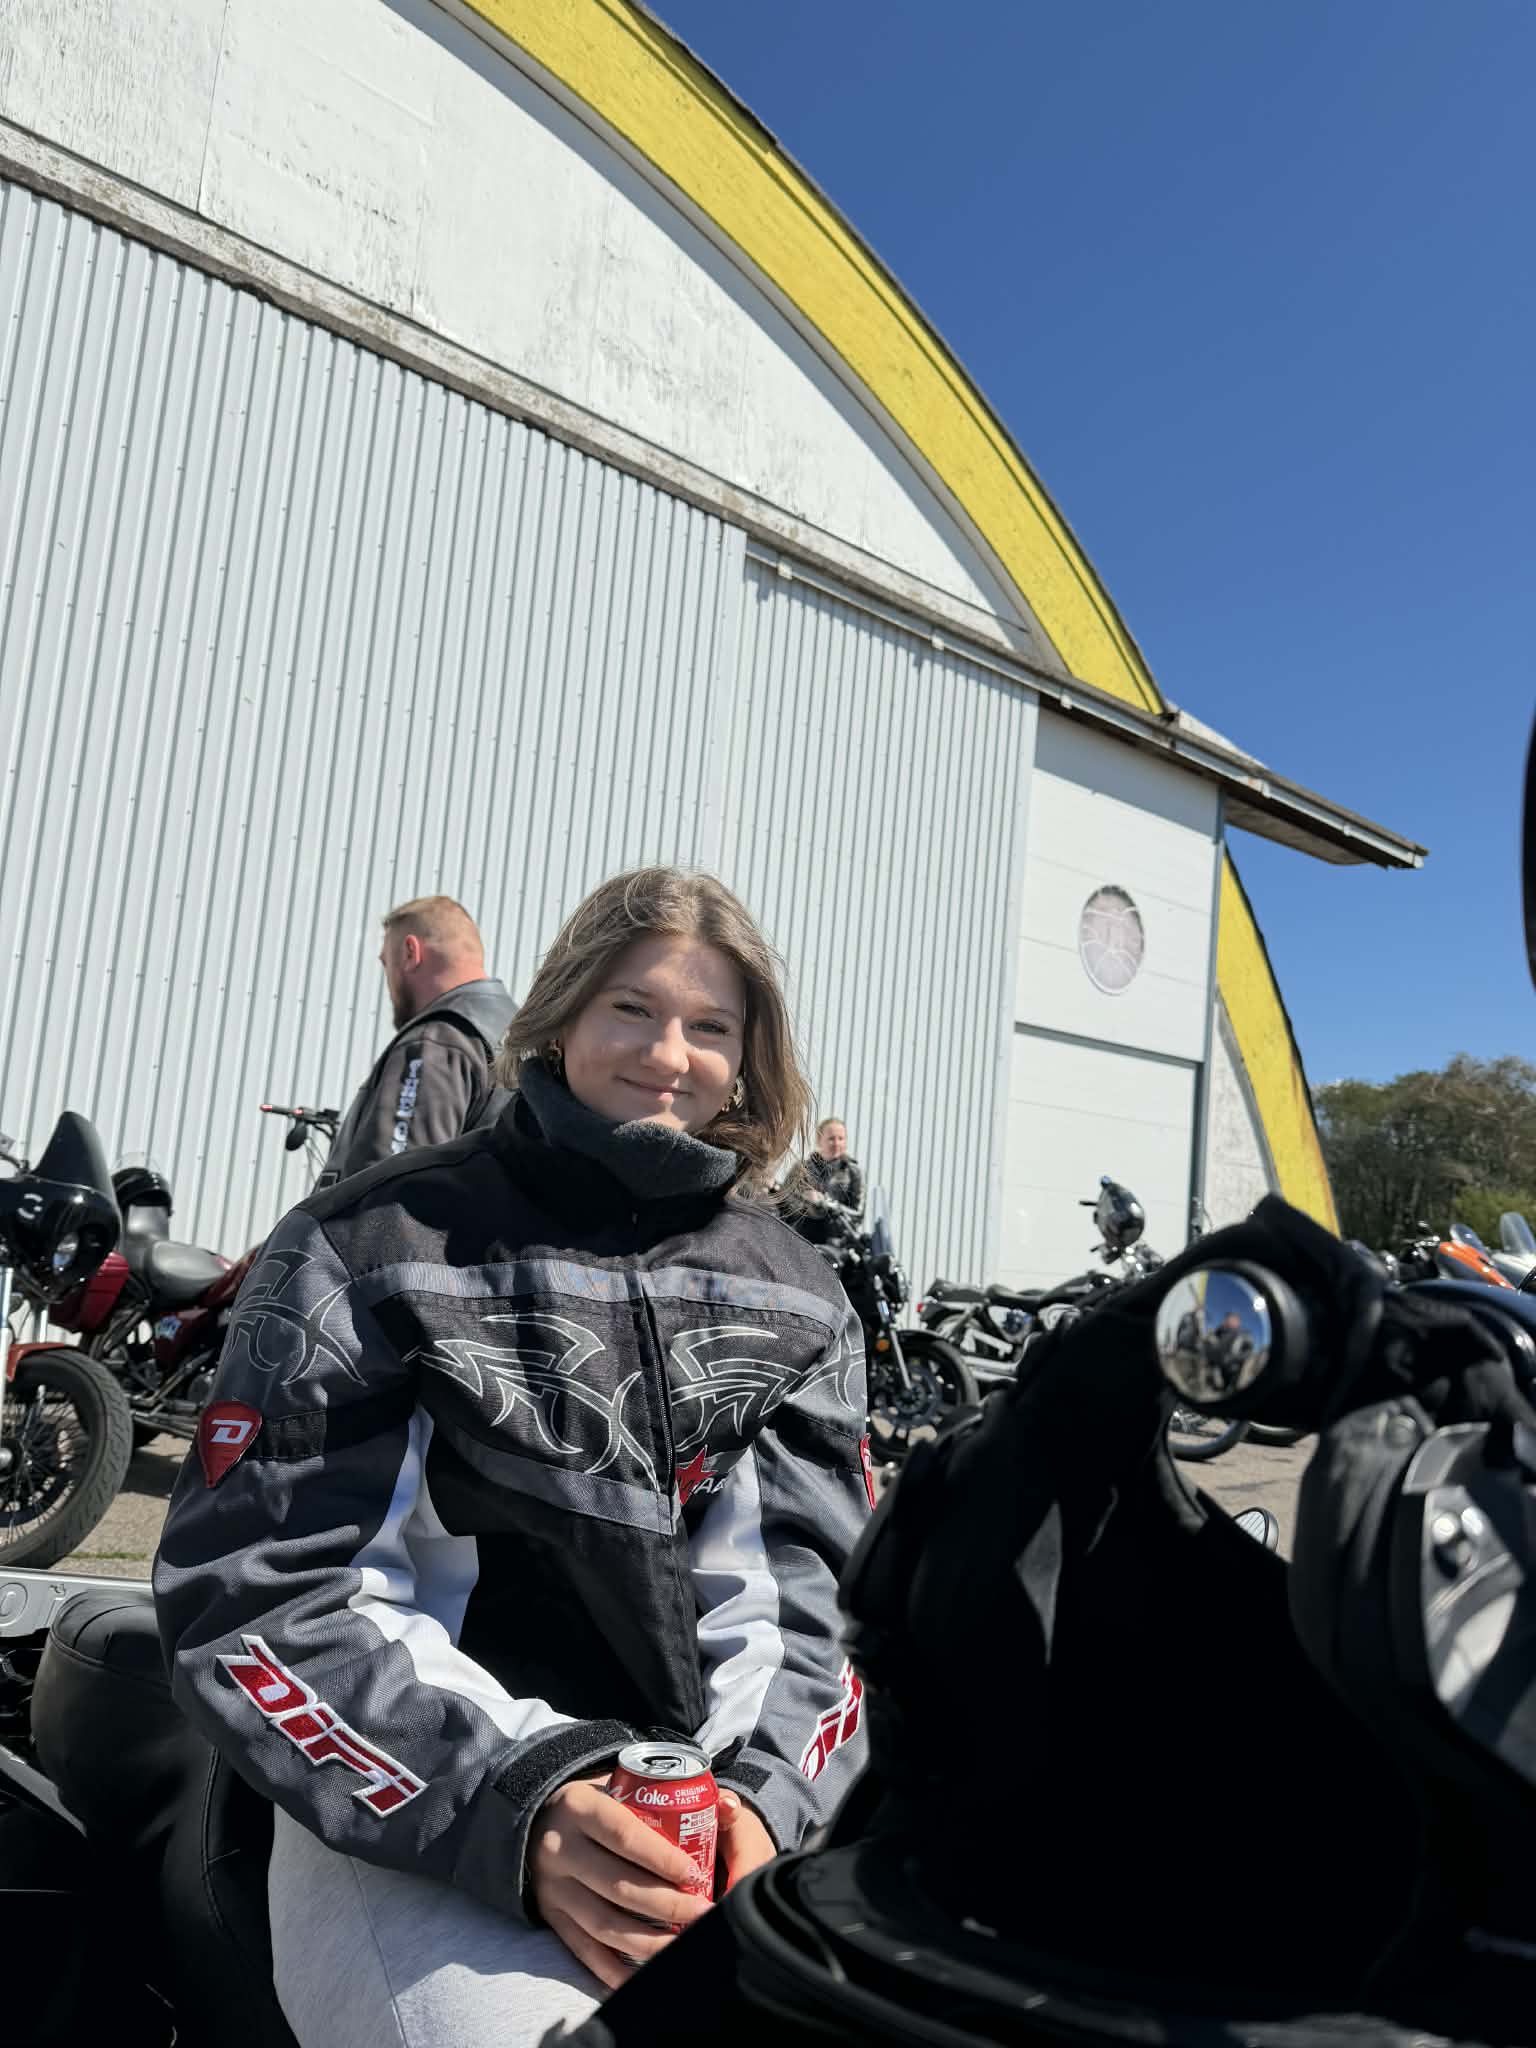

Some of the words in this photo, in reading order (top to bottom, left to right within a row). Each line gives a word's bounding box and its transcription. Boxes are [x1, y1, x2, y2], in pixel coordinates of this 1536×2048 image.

[209, 1418, 253, 1444] D
[635, 1786, 670, 1806] Coke
[674, 1784, 708, 1798] ORIGINAL
[675, 1794, 701, 1806] TASTE
